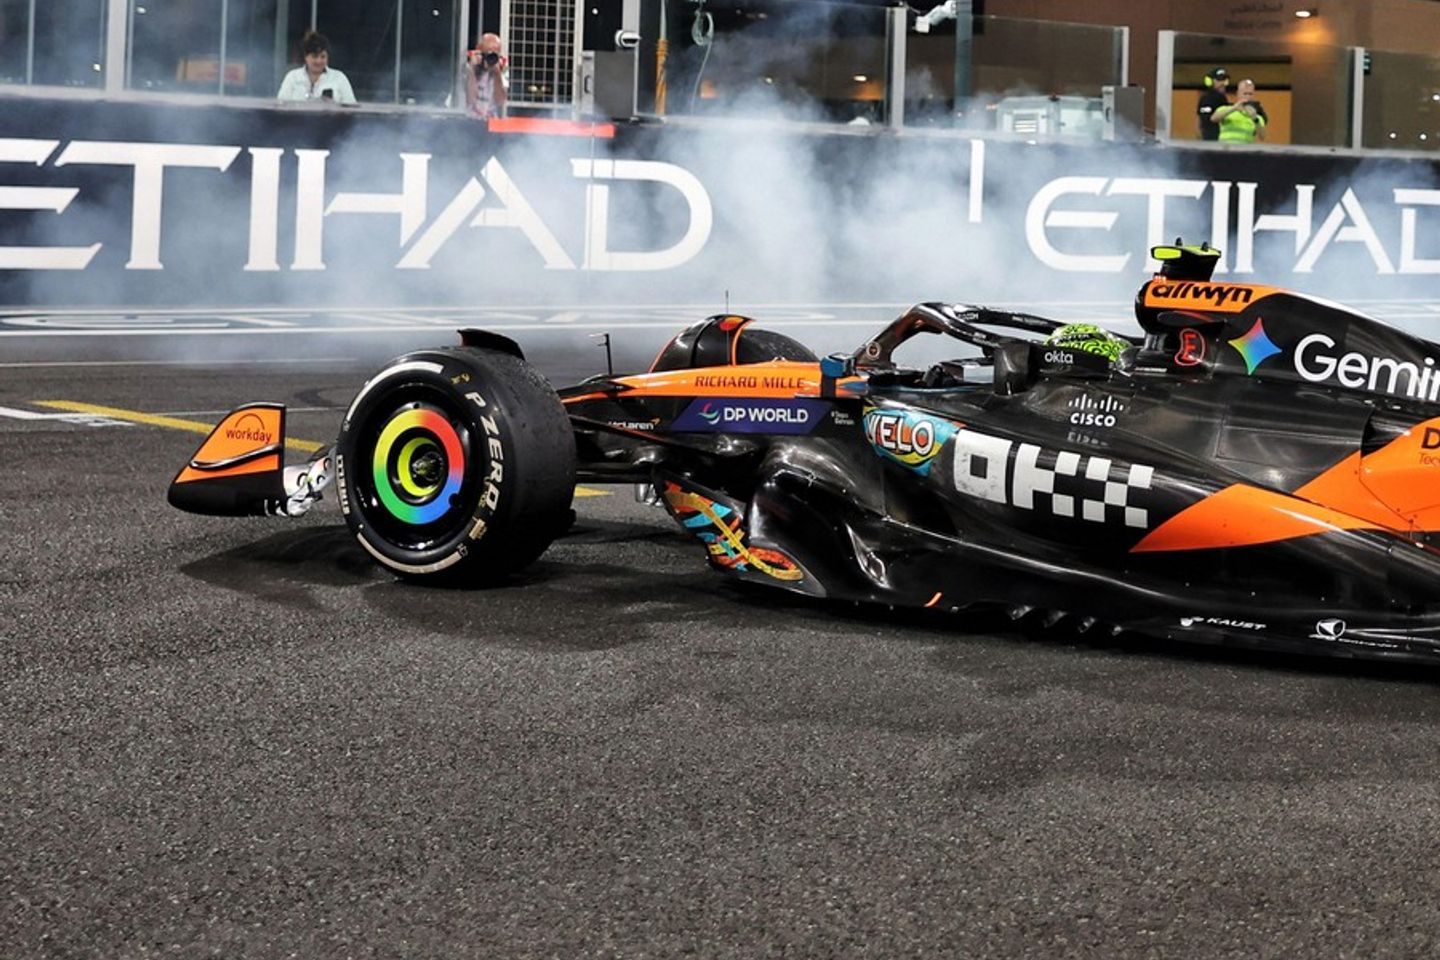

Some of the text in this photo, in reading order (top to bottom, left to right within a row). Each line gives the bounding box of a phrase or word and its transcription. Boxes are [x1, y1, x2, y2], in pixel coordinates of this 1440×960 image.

[1151, 282, 1254, 307] allwyn
[1044, 350, 1074, 365] okta
[694, 375, 805, 389] RICHARD MILLE
[723, 406, 809, 423] DP WORLD
[863, 414, 935, 455] VELO
[463, 391, 487, 409] P
[480, 414, 506, 511] ZERO
[954, 429, 1155, 529] OKX
[1207, 616, 1267, 630] KAUST
